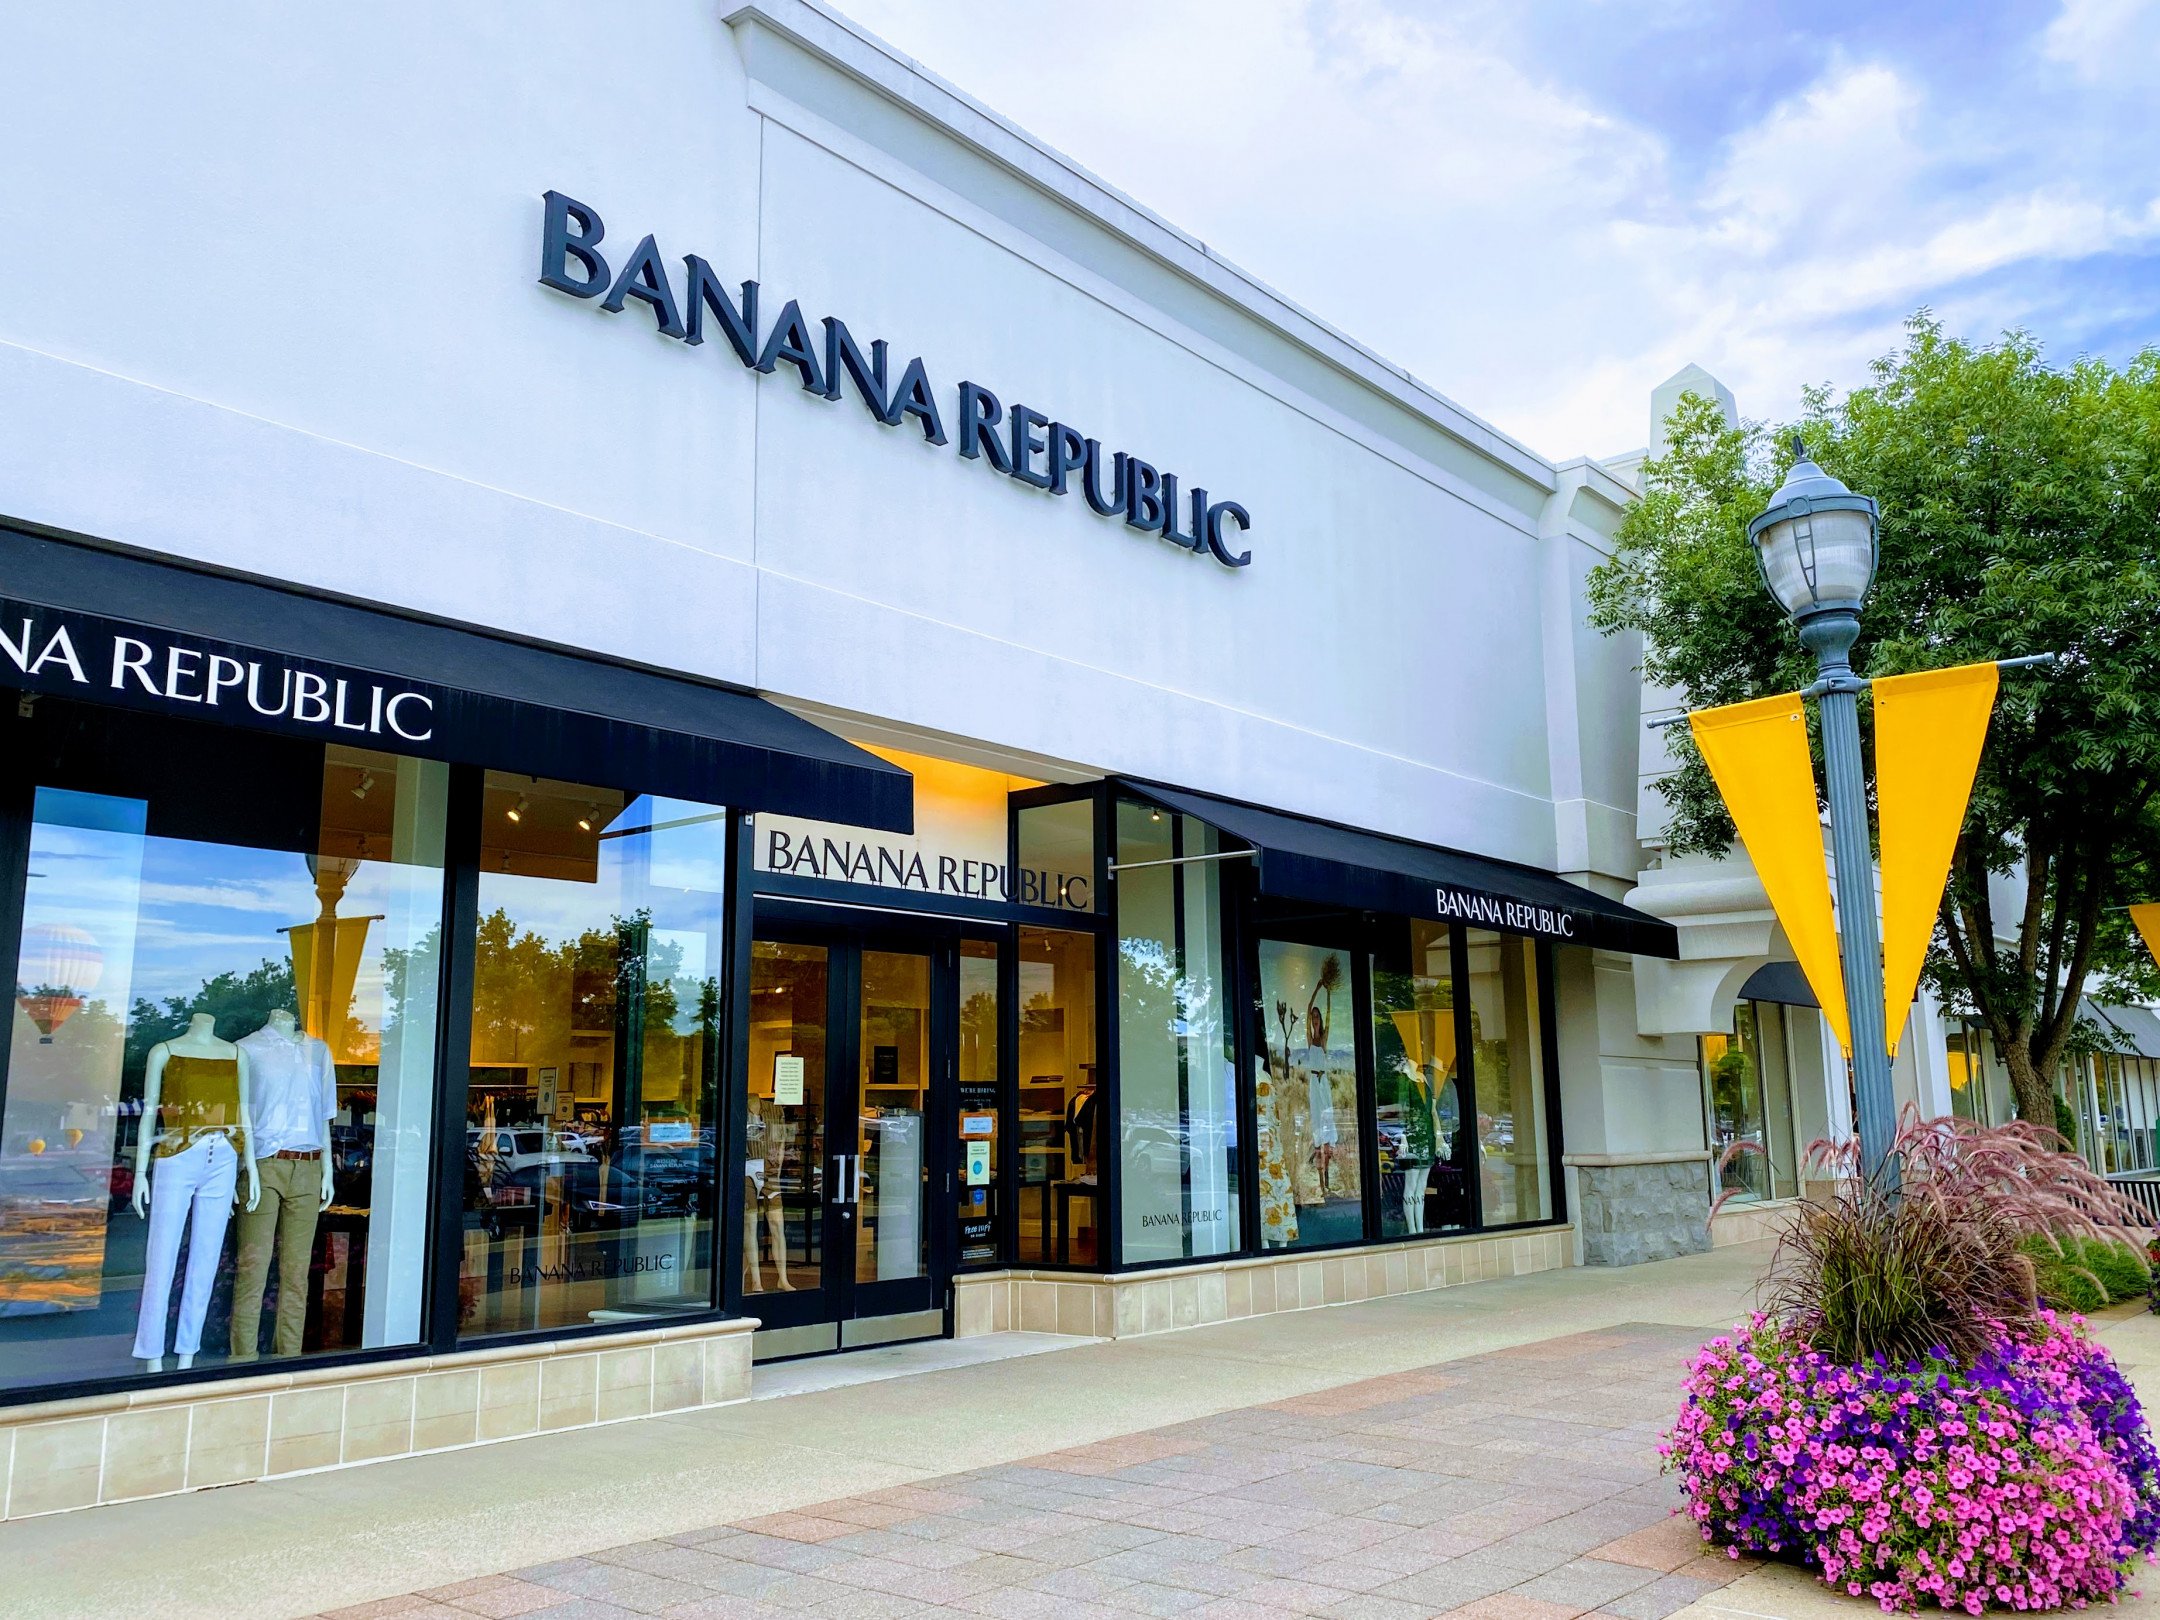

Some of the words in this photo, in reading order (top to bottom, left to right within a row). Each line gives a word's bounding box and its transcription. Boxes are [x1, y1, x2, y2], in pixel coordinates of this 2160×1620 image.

[539, 190, 948, 446] BANANA
[959, 381, 1251, 567] REPUBLIC
[110, 636, 432, 740] REPUBLIC
[768, 830, 930, 888] BANANA
[939, 856, 1088, 909] REPUBLIC
[1436, 889, 1503, 924] BANANA
[1506, 902, 1573, 937] REPUBLIC
[1142, 1213, 1180, 1227] BANANA
[1181, 1209, 1222, 1226] REPUBLIC
[510, 1262, 585, 1284] BANANA
[591, 1254, 672, 1277] REPUBLIC
